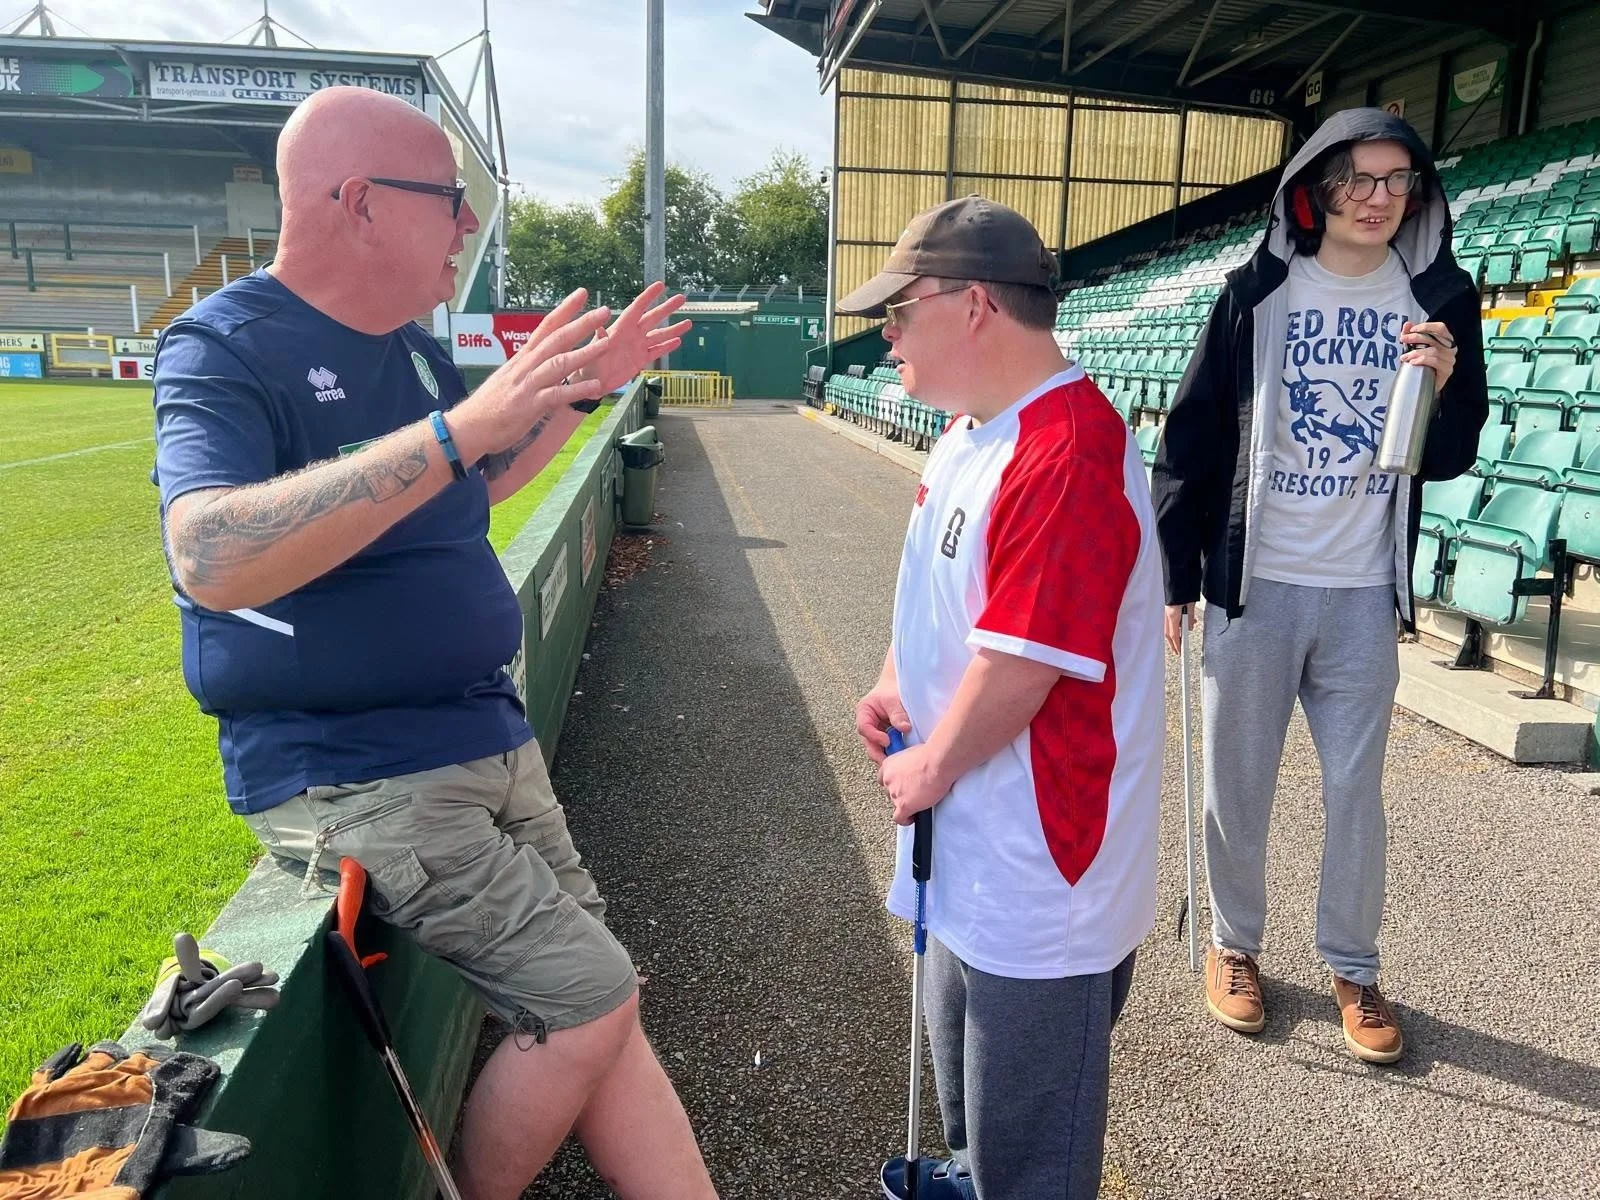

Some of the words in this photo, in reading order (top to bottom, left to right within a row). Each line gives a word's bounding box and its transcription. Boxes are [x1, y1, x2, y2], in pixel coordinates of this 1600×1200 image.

[0, 57, 20, 74] LE
[155, 64, 297, 88] TRANSPORT
[310, 72, 417, 95] SYSTEMS
[235, 90, 275, 99] FLEET
[1307, 80, 1321, 97] GG
[808, 324, 818, 339] 4
[1287, 309, 1323, 342] ED
[0, 338, 22, 347] HERS
[458, 333, 492, 347] Biffa
[501, 331, 532, 340] Wast
[1282, 338, 1404, 371] TOCKYAR
[144, 364, 154, 376] S
[1352, 378, 1379, 401] 25
[1306, 447, 1331, 469] 19
[1269, 470, 1358, 499] RESCOTT,
[1365, 473, 1390, 496] AZ
